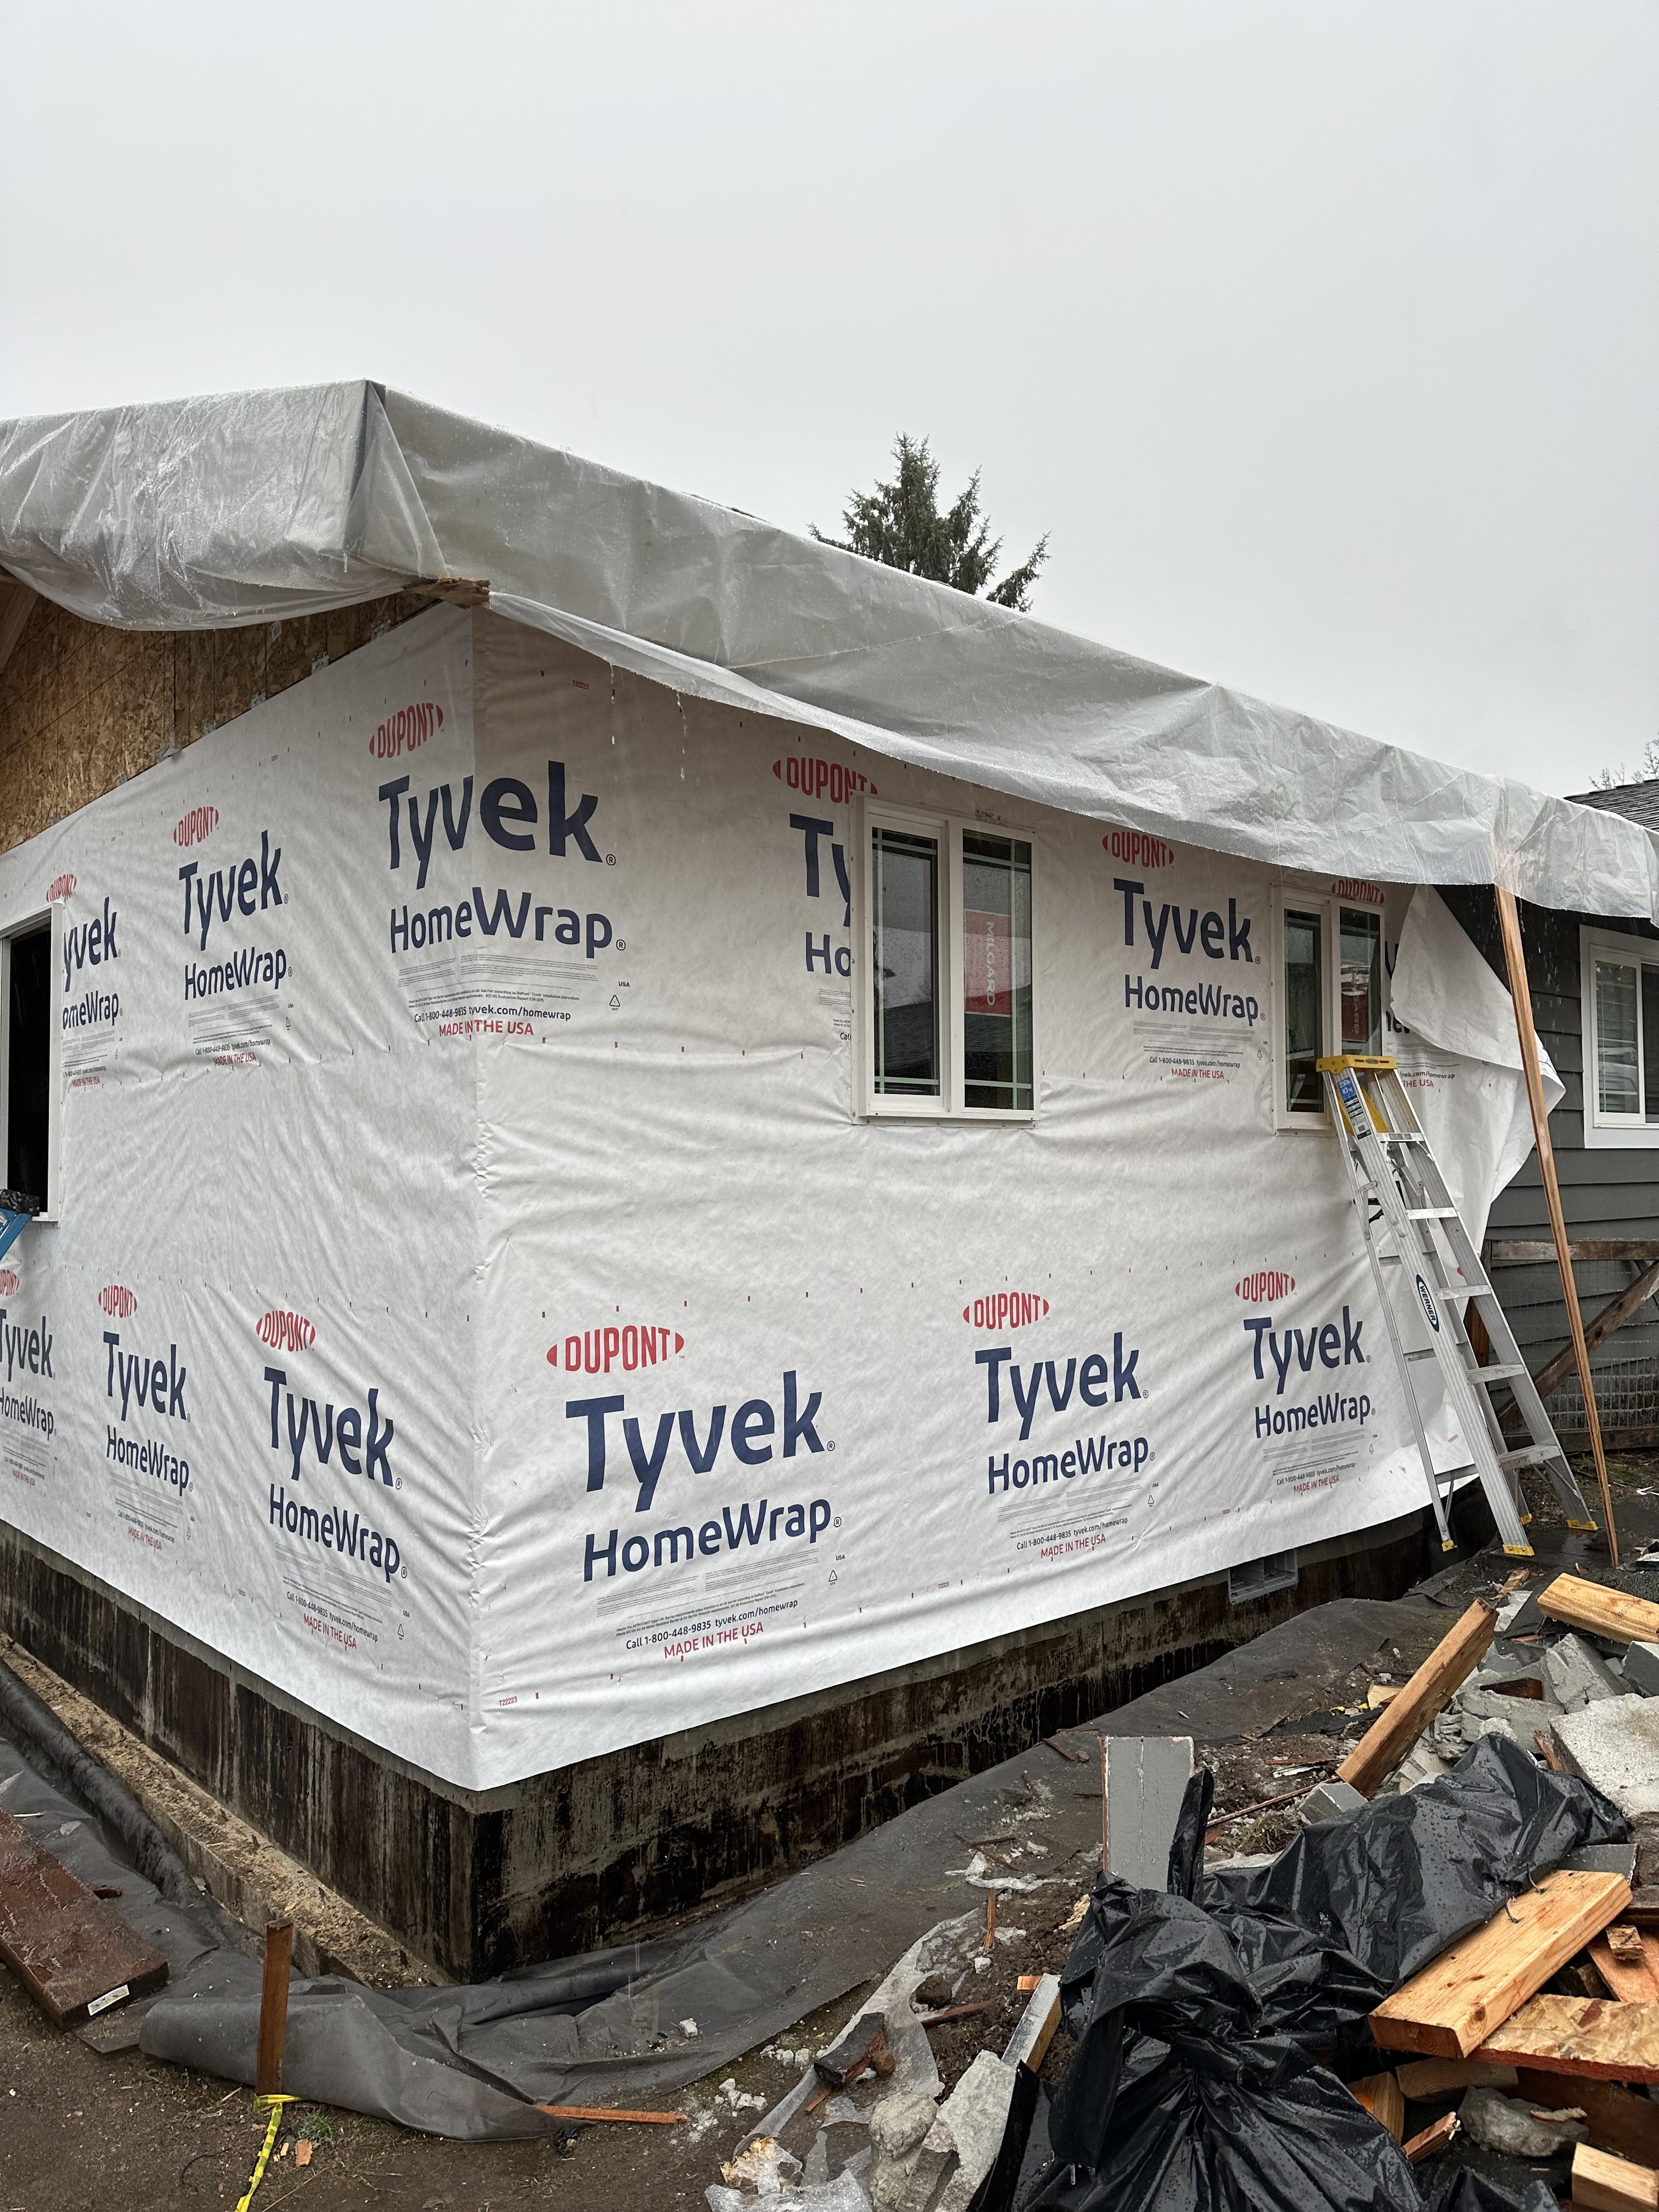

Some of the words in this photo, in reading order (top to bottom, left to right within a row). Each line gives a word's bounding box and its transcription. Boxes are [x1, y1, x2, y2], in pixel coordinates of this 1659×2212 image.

[986, 921, 996, 1006] MILGARD
[414, 1014, 425, 1023] Call
[469, 1004, 571, 1022] tyvek.com/homewrap
[439, 1022, 464, 1037] MADE
[465, 1020, 473, 1034] IN
[474, 1019, 504, 1034] THE
[507, 1020, 534, 1036] USA
[1171, 1068, 1191, 1078] MADE
[1191, 1069, 1198, 1077] IN
[1198, 1069, 1210, 1079] THE
[1211, 1070, 1224, 1080] USA
[1419, 1079, 1434, 1088] USA
[103, 1285, 133, 1318] DUPONT
[1242, 1271, 1290, 1303] DUPONT
[973, 1292, 1041, 1330] DUPONT
[1419, 1285, 1437, 1322] WERNER
[261, 1310, 311, 1352] DUPONT
[565, 1325, 672, 1374] DUPONT
[1276, 1477, 1284, 1486] Call
[1294, 1481, 1311, 1493] MADE
[1311, 1480, 1317, 1489] IN
[1318, 1477, 1328, 1488] THE
[1329, 1474, 1340, 1485] USA
[1017, 1539, 1028, 1550] Call
[1040, 1544, 1064, 1559] MADE
[1065, 1541, 1073, 1553] IN
[1075, 1537, 1090, 1550] THE
[1091, 1533, 1106, 1546] USA
[286, 1590, 295, 1601] Call
[303, 1612, 322, 1633] MADE
[323, 1622, 330, 1636] IN
[330, 1626, 343, 1643] THE
[343, 1633, 357, 1650] USA
[626, 1637, 642, 1650] Call
[644, 1620, 712, 1645] 1-800-448-9835
[715, 1600, 799, 1628] tyvek.com/homewrap
[664, 1638, 699, 1659] MADE
[702, 1634, 714, 1649] IN
[716, 1627, 739, 1645] THE
[742, 1621, 764, 1638] USA
